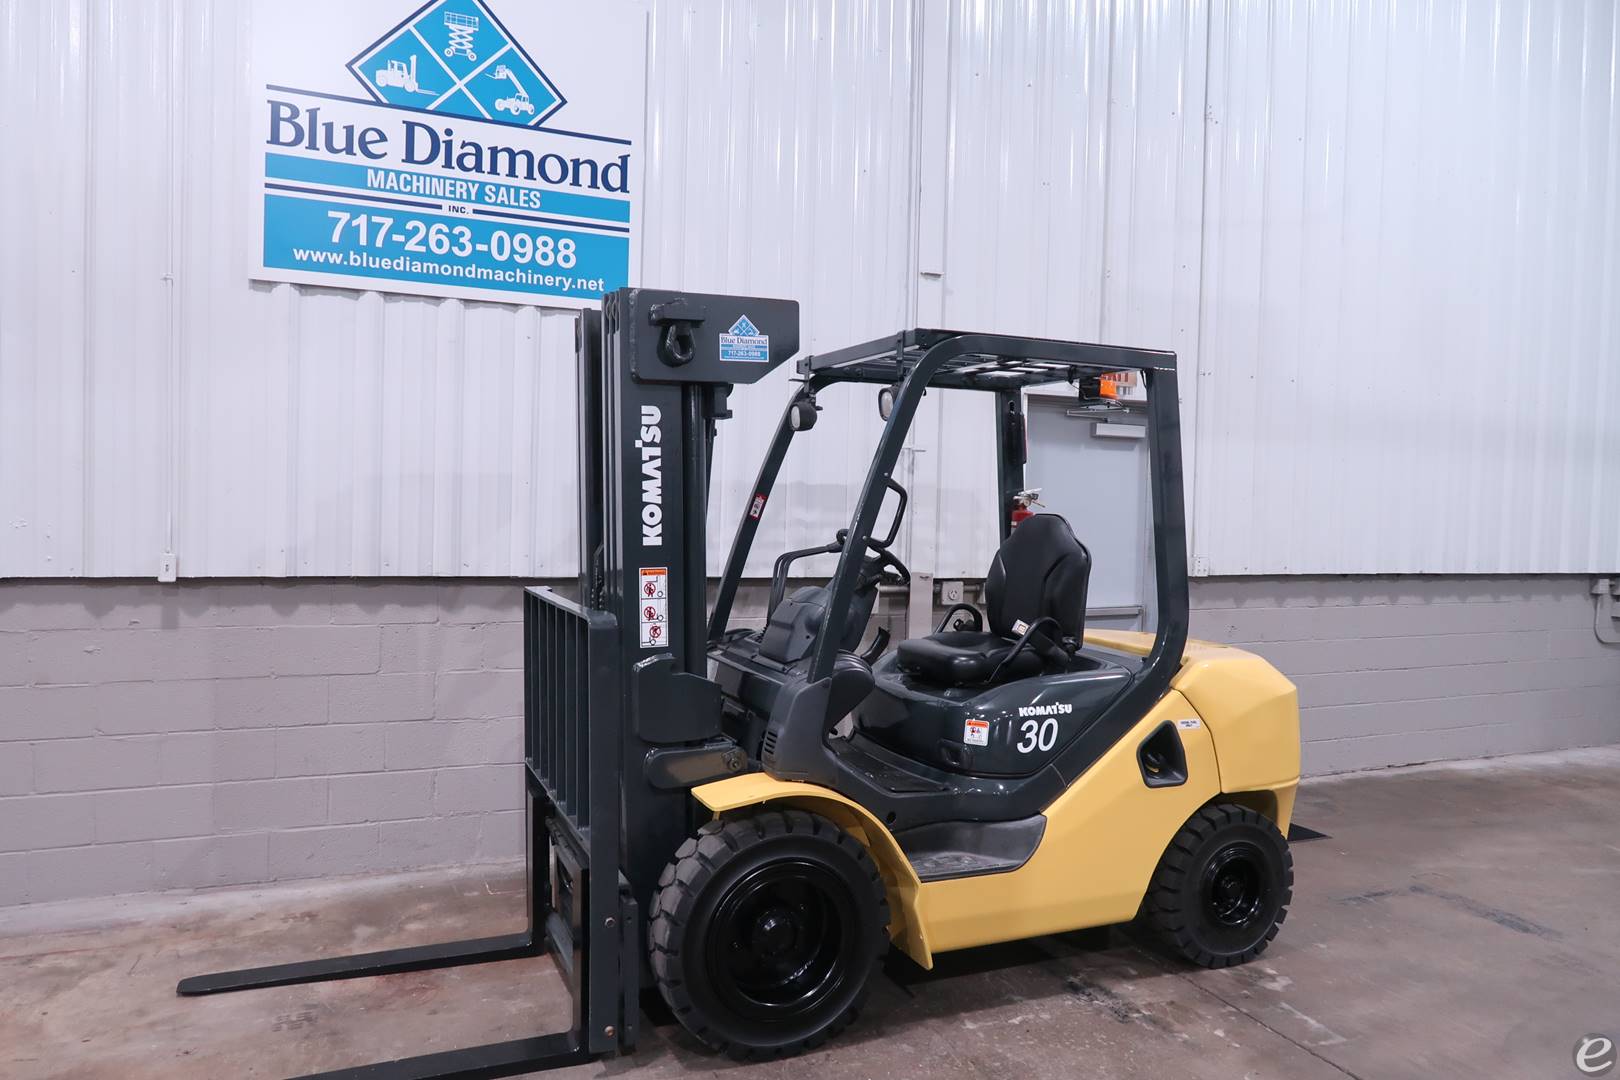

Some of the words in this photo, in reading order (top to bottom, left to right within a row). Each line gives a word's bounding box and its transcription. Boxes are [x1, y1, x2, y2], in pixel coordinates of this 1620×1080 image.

[266, 99, 388, 160] Blue
[401, 120, 631, 193] Diamond
[367, 168, 480, 202] MACHINERY
[484, 184, 542, 209] SALES
[448, 204, 470, 215] INC.
[328, 211, 578, 269] 717-263-0988
[292, 247, 605, 291] www.bluediamondmachinery.net
[635, 405, 663, 546] KOMATSU
[1018, 701, 1073, 717] KOMATSU
[1016, 718, 1059, 754] 30
